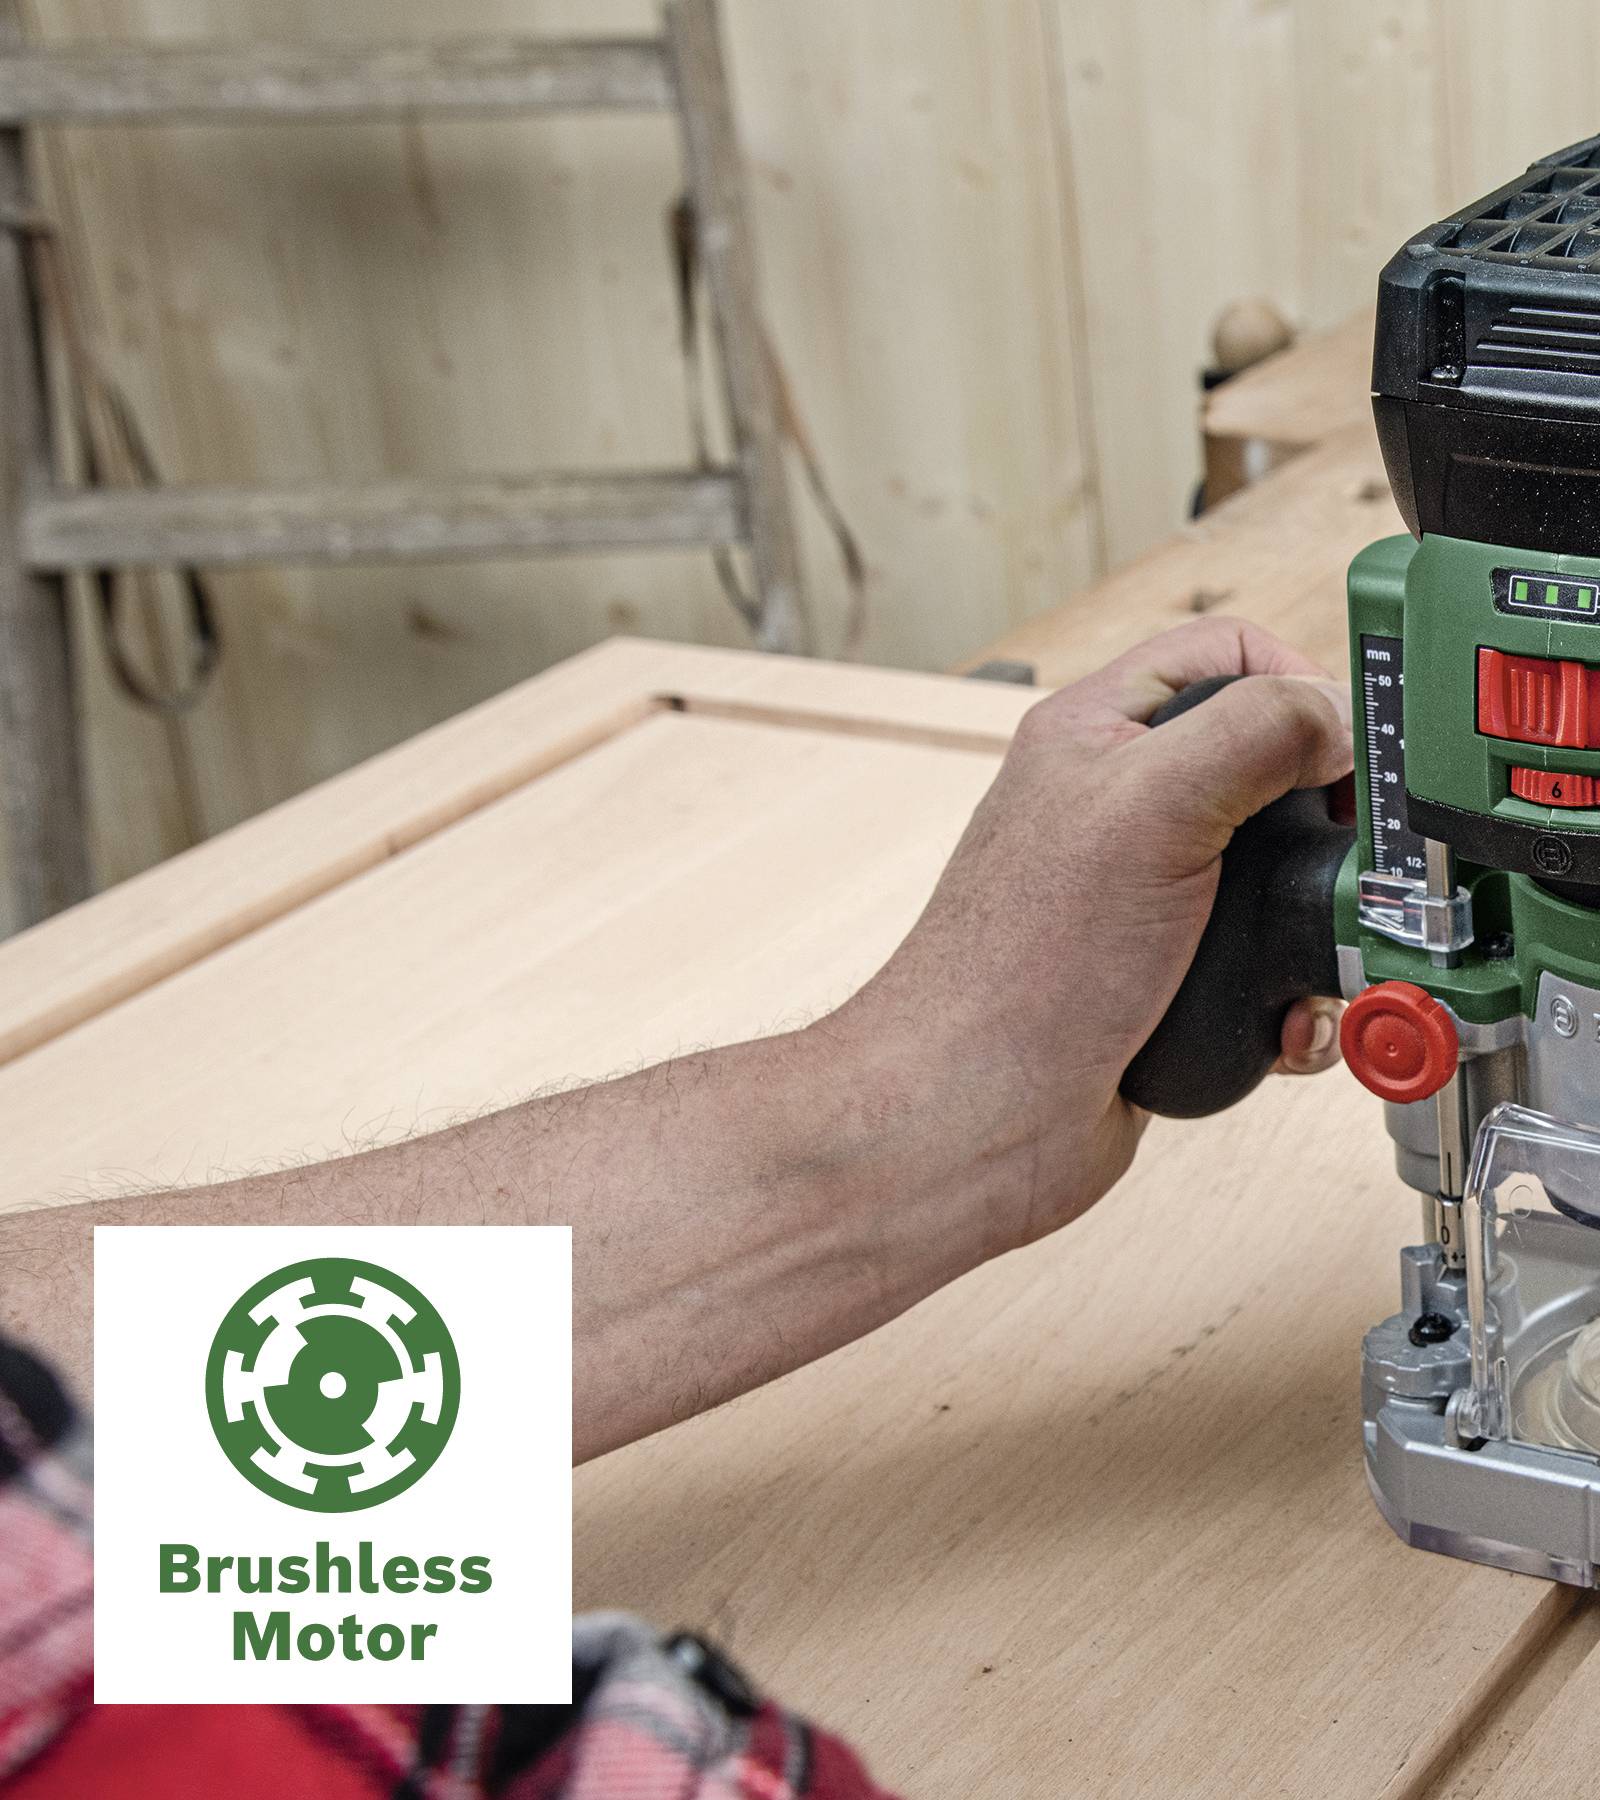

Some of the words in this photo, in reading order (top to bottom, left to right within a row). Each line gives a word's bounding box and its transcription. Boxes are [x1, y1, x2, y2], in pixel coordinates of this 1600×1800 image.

[1366, 649, 1391, 661] mm
[1378, 674, 1392, 687] 50
[1381, 723, 1395, 736] 40
[1384, 771, 1398, 783] 30
[1551, 781, 1562, 799] 6
[1387, 818, 1401, 830] 20
[1390, 866, 1403, 878] 10
